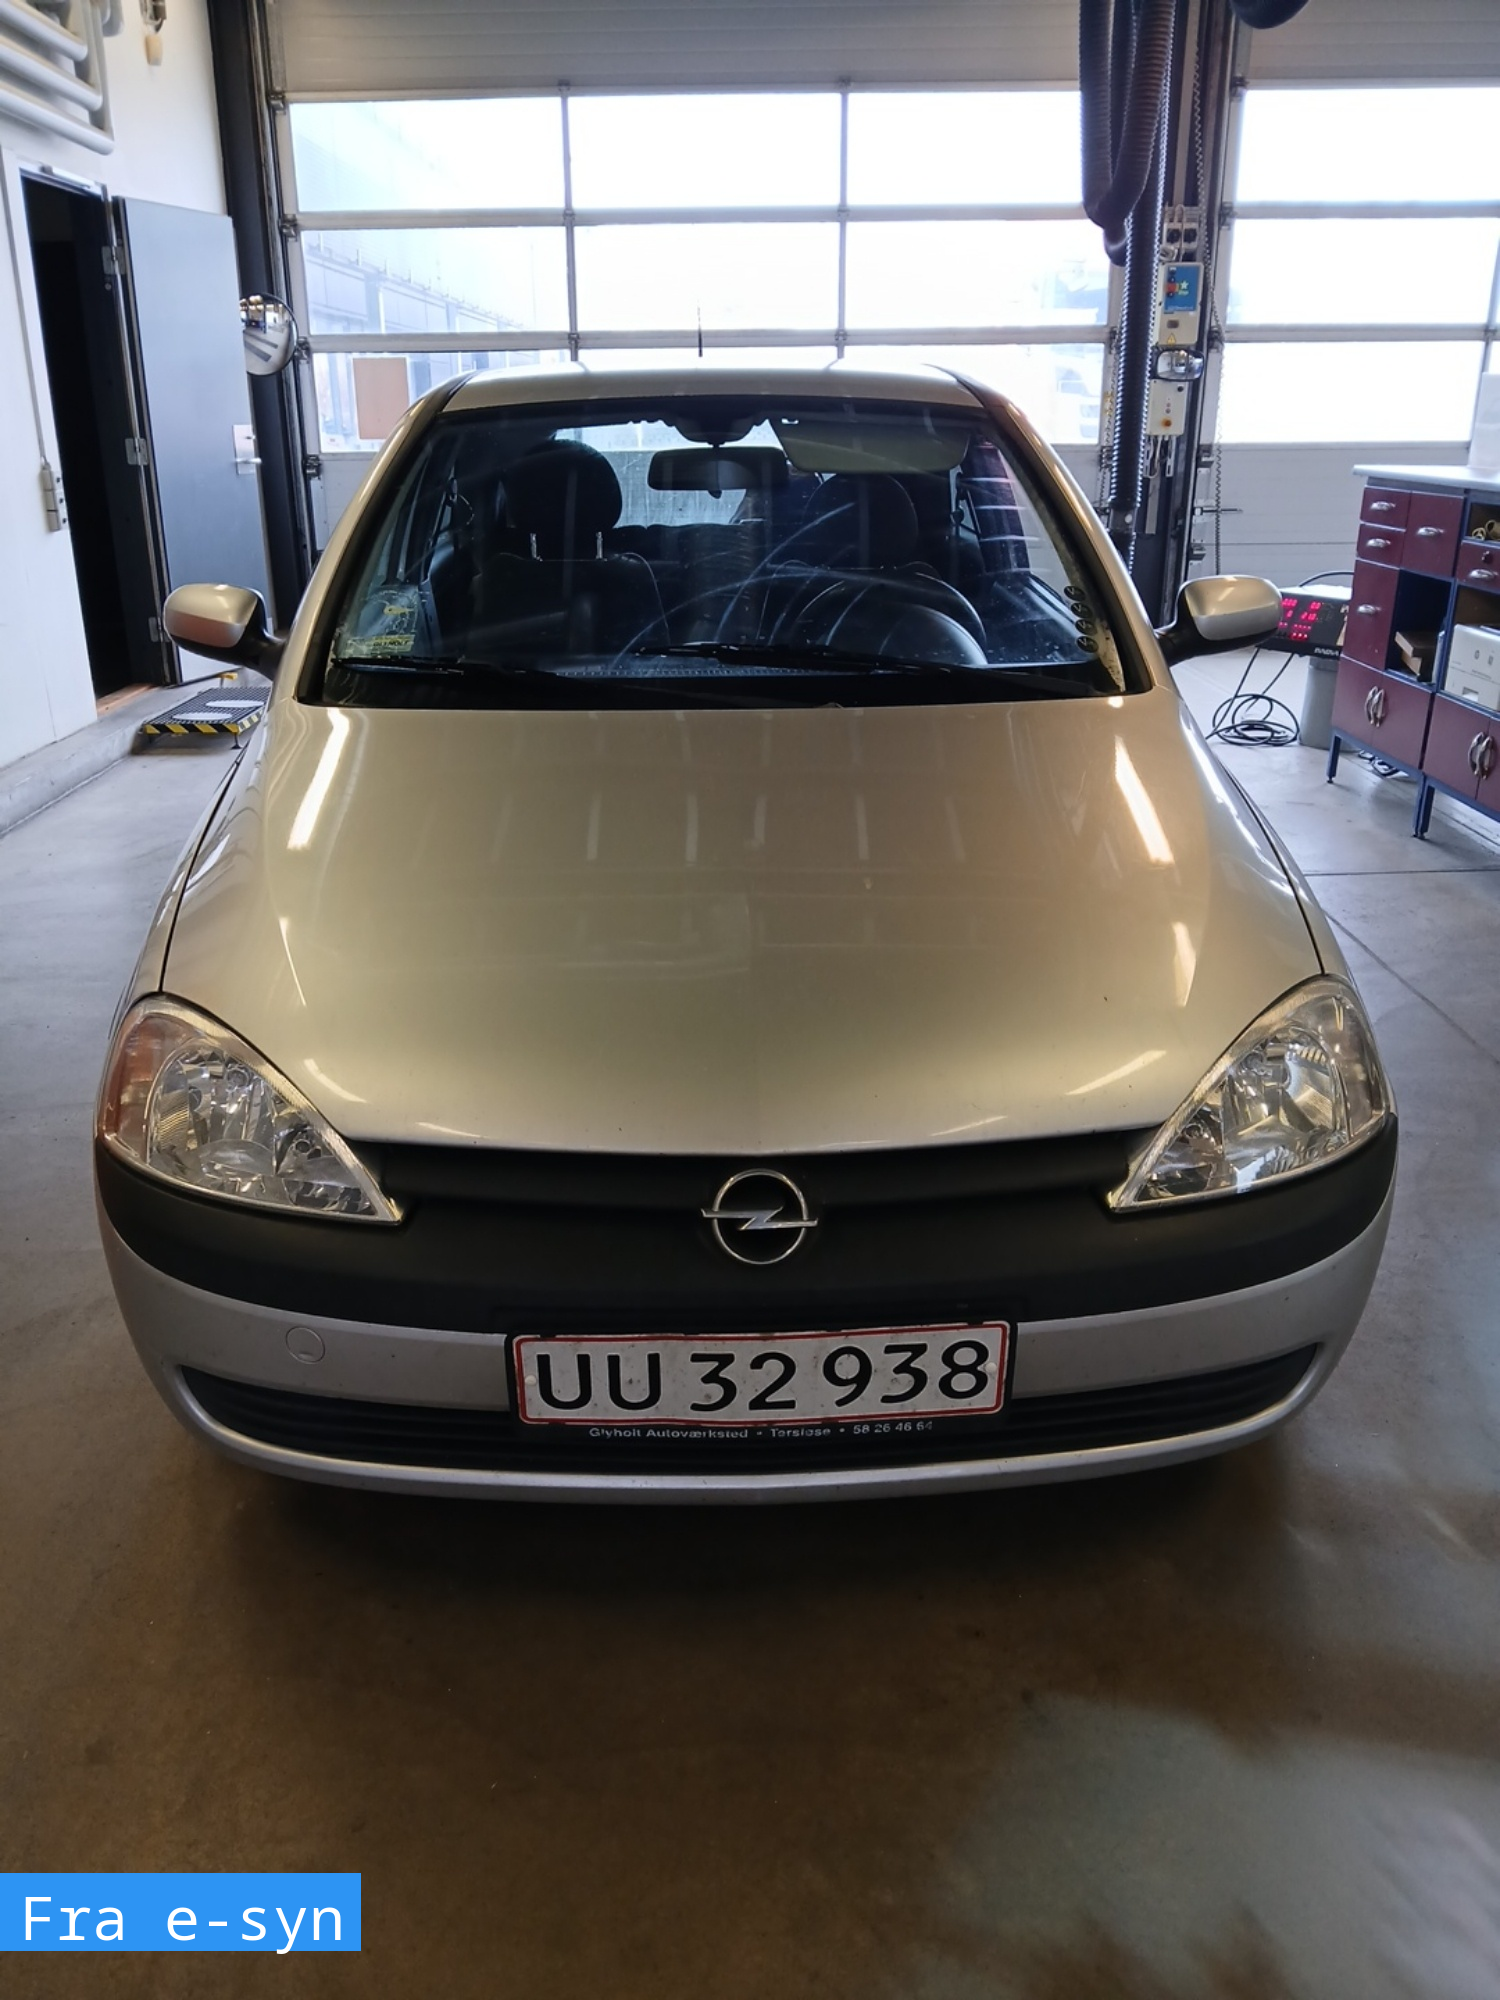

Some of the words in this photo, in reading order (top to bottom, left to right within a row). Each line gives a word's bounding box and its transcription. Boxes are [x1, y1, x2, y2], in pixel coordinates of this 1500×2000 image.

[536, 1350, 662, 1411] UU
[689, 1351, 798, 1412] 32
[821, 1340, 991, 1408] 938
[589, 1427, 641, 1439] Glyholt
[853, 1424, 870, 1435] 58
[874, 1422, 891, 1433] 26
[895, 1421, 912, 1432] 46
[916, 1420, 933, 1431] 64
